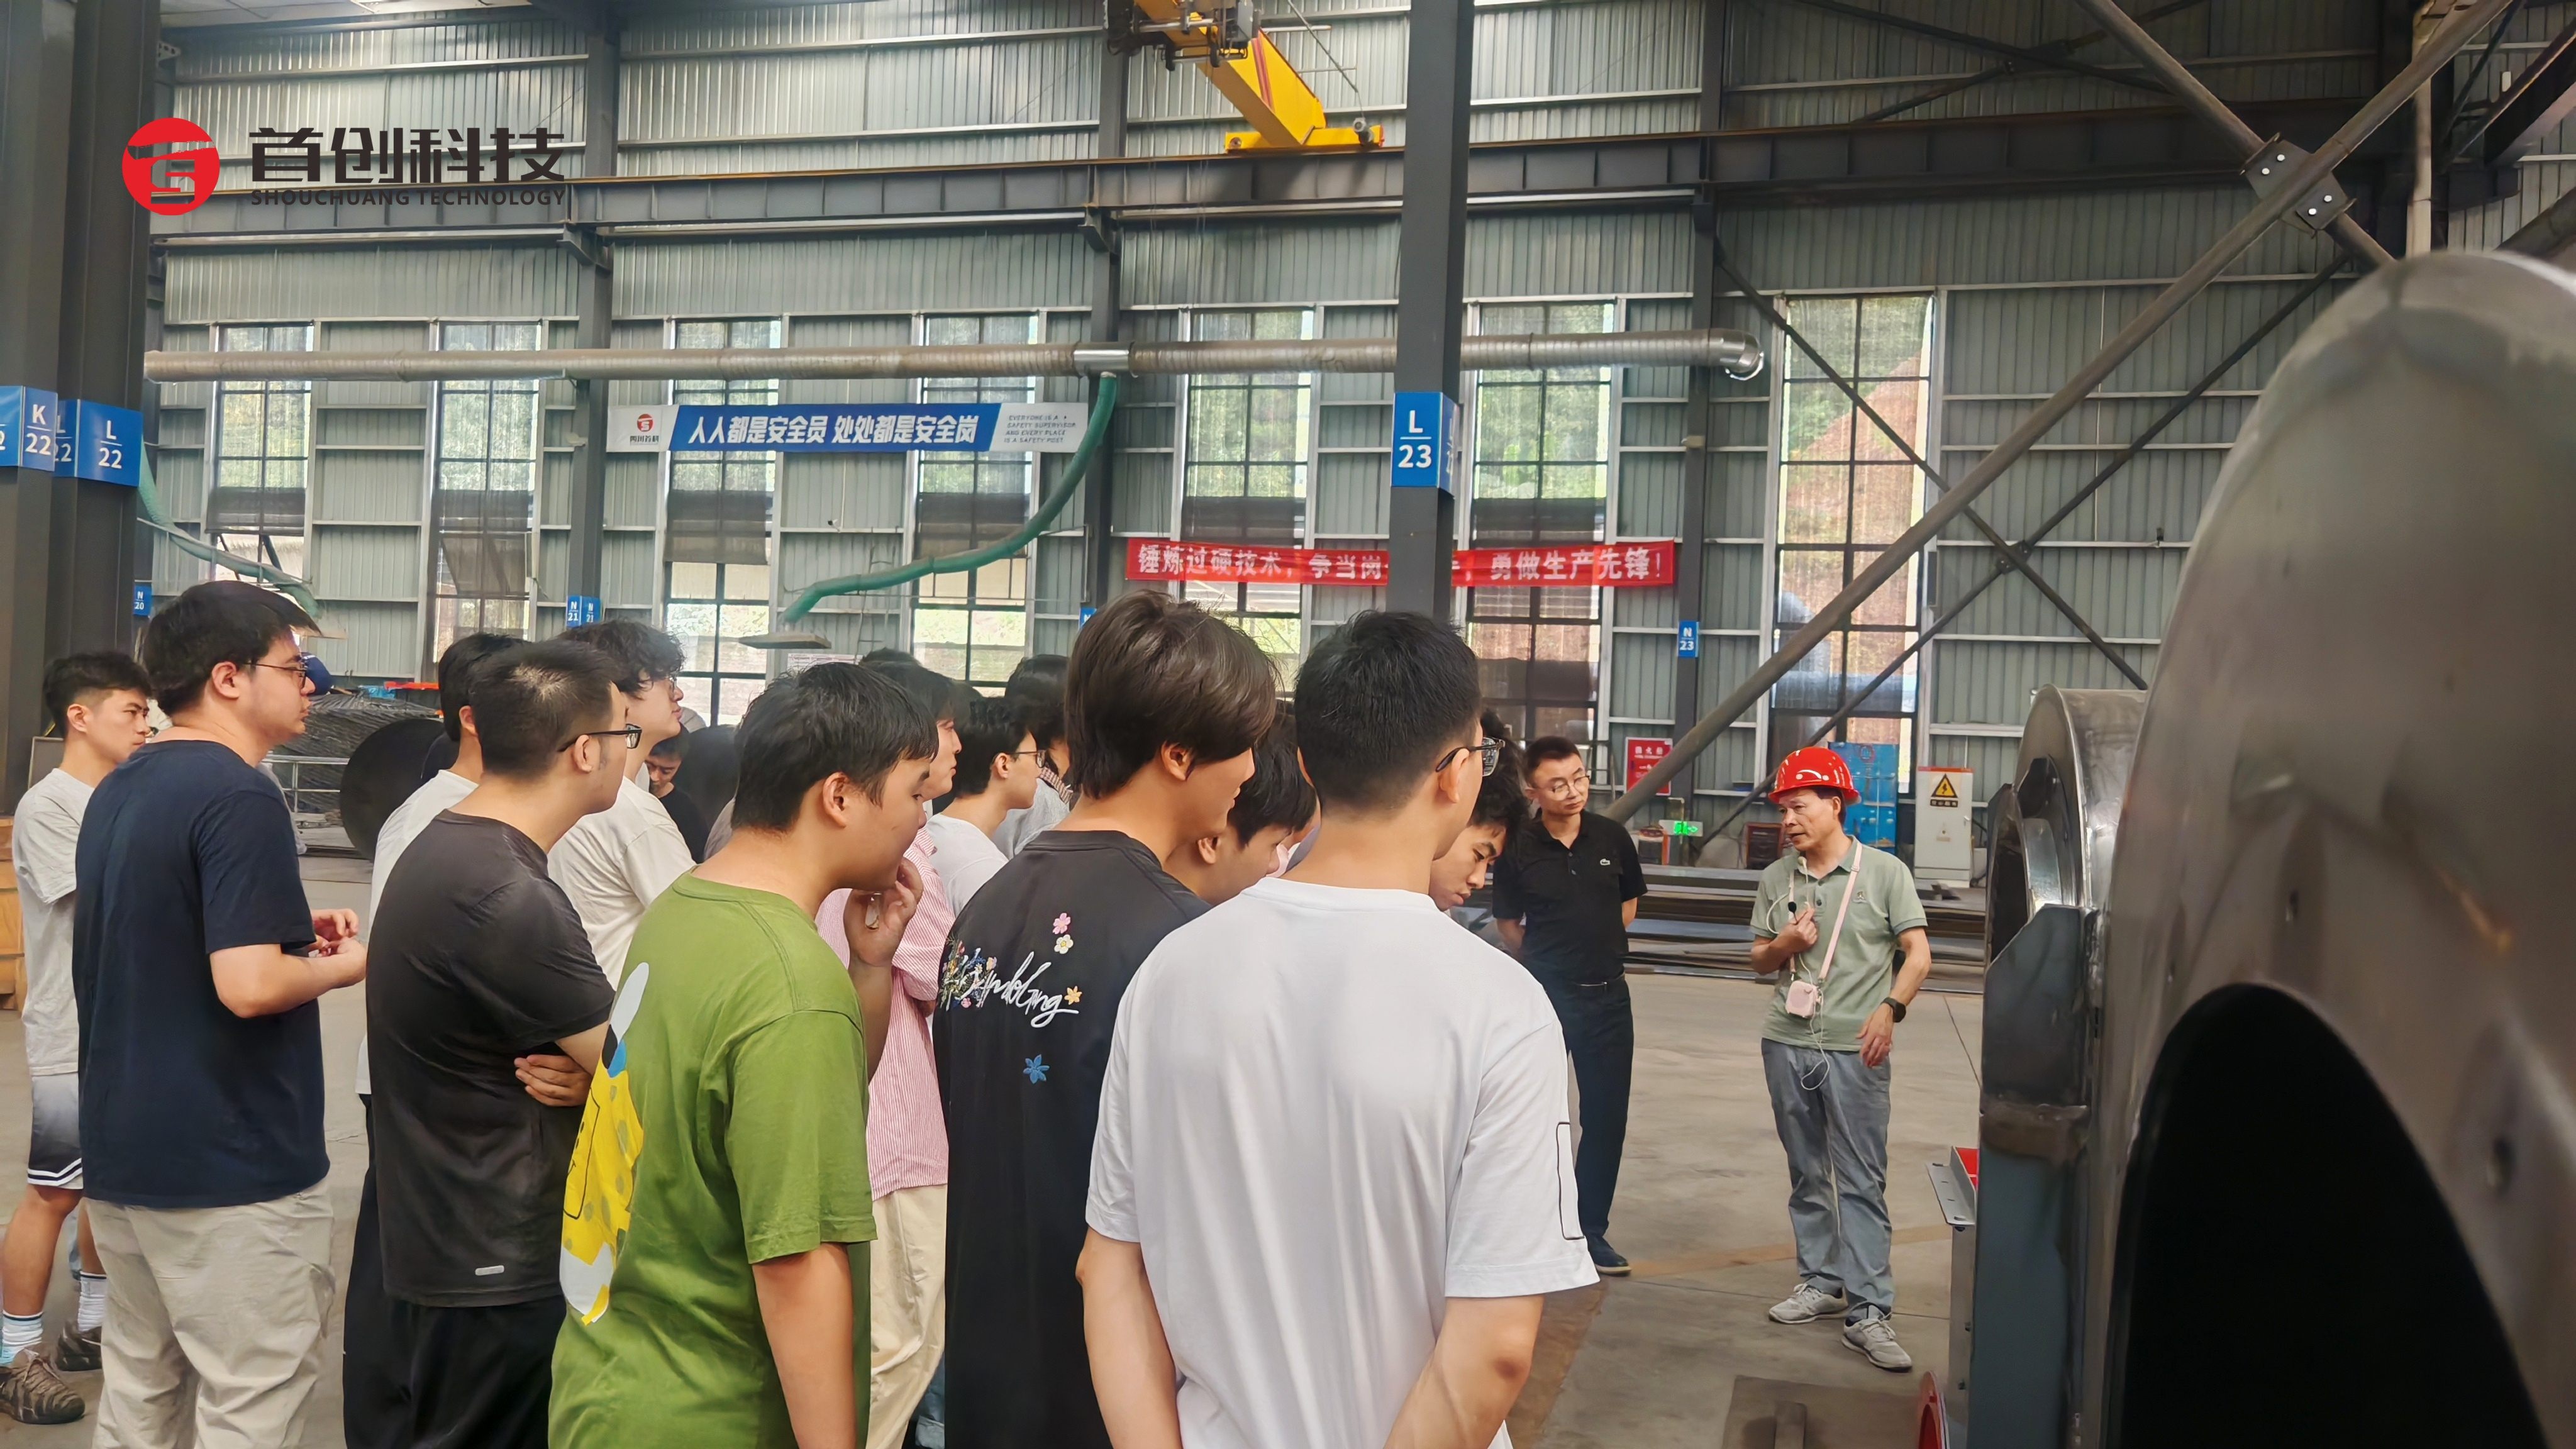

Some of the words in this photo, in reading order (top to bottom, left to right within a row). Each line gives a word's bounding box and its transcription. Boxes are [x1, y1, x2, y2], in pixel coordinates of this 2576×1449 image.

[33, 404, 46, 425] K
[1409, 410, 1424, 433] L
[106, 420, 117, 440] L
[688, 415, 828, 444] 人人都是安全员
[831, 414, 980, 444] 处处都是安全岗
[25, 433, 52, 455] 22
[98, 447, 123, 469] 22
[1398, 444, 1432, 469] 23
[137, 591, 143, 599] N
[570, 601, 577, 610] N
[588, 602, 594, 611] N
[568, 612, 579, 621] 21
[586, 614, 594, 623] 21
[1683, 626, 1692, 638] N
[1679, 640, 1694, 651] 23
